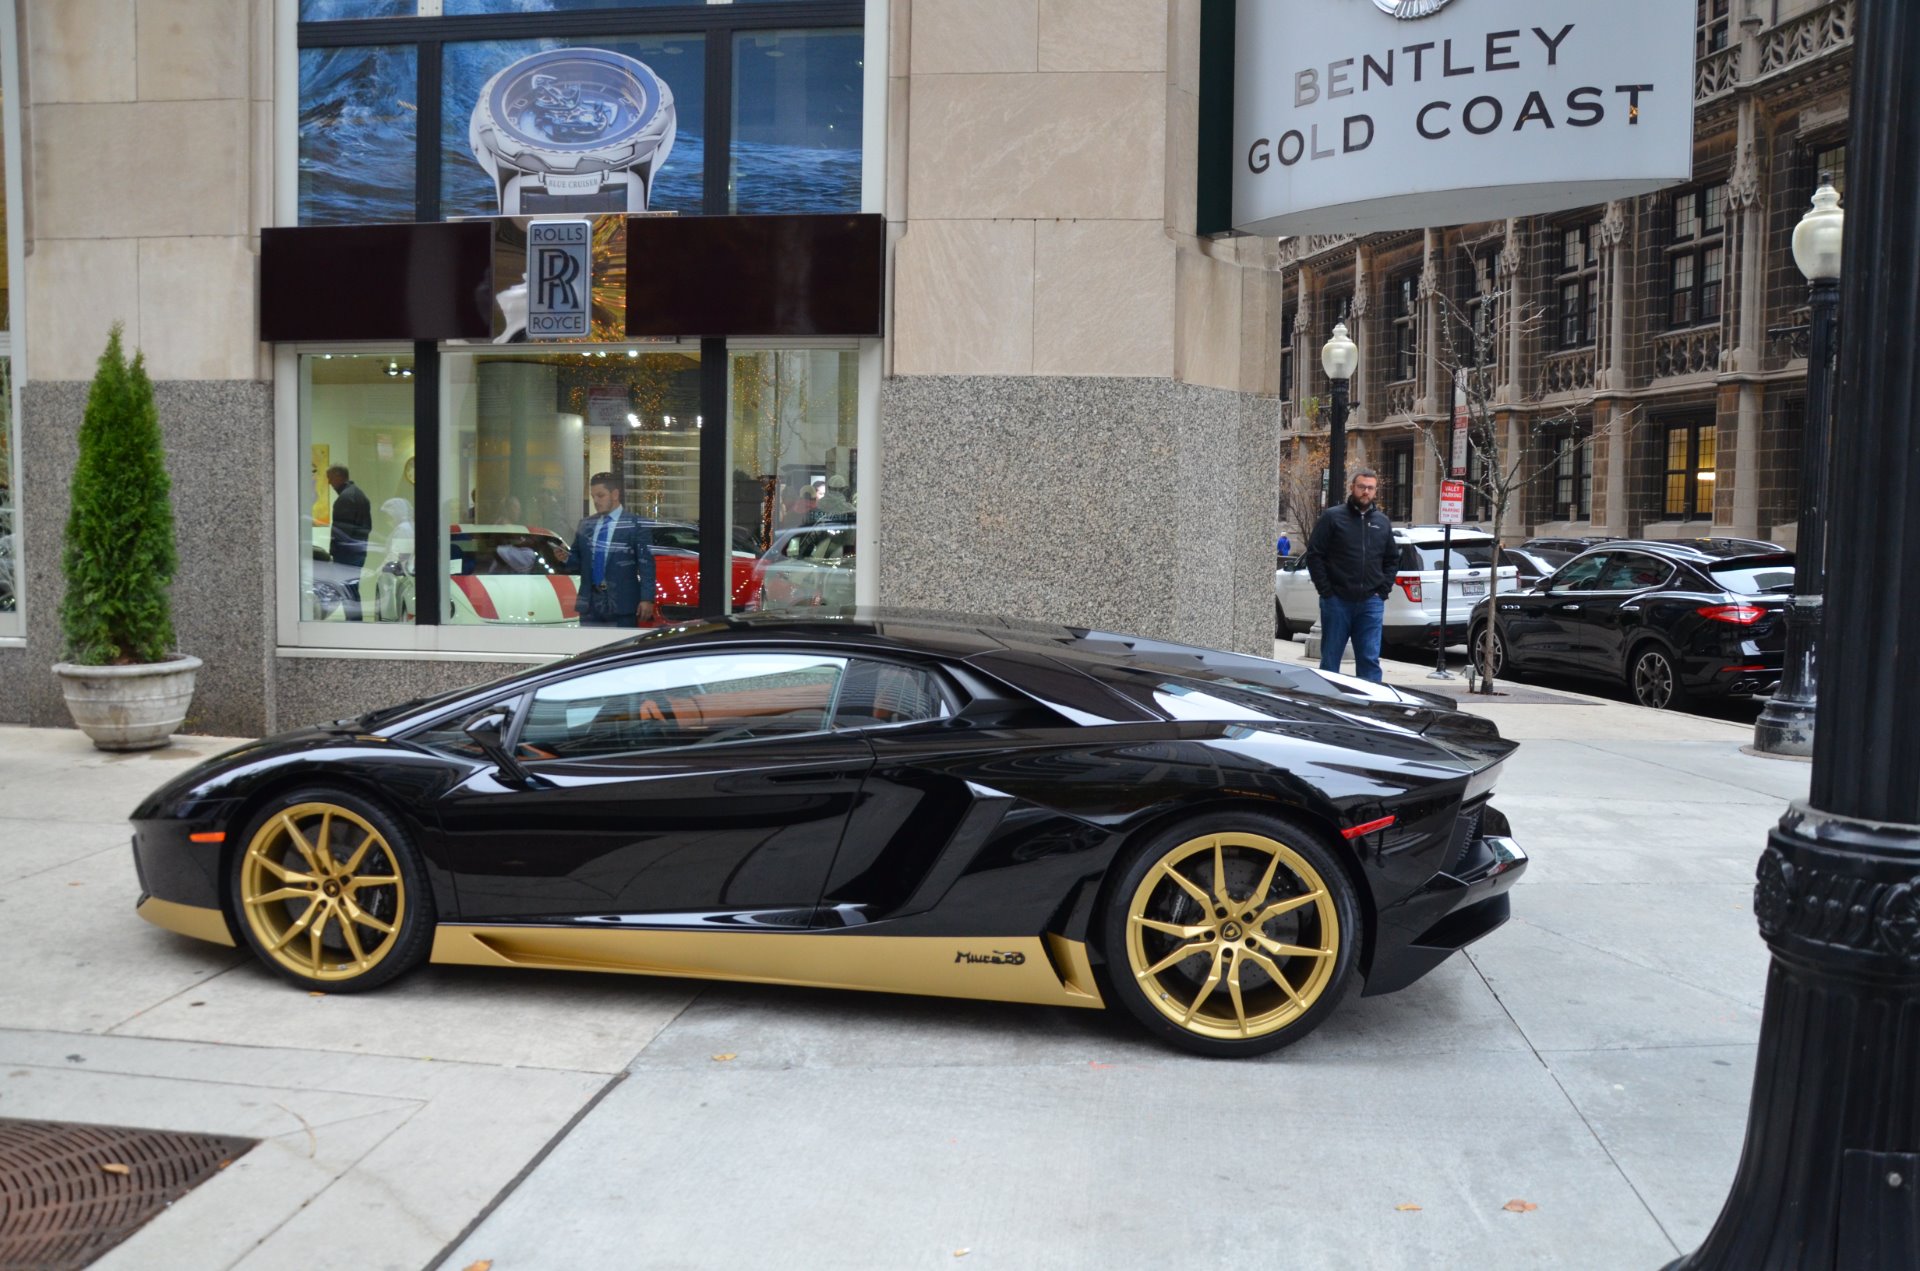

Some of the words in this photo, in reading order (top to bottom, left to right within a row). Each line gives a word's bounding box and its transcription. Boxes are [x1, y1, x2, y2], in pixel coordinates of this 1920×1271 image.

[1294, 24, 1575, 108] BENTLEY
[1248, 113, 1375, 174] GOLD
[1416, 84, 1654, 140] COAST
[549, 180, 566, 188] BLUE
[568, 178, 598, 188] CRUISER
[533, 227, 583, 241] ROLLS
[532, 316, 581, 330] ROYCE
